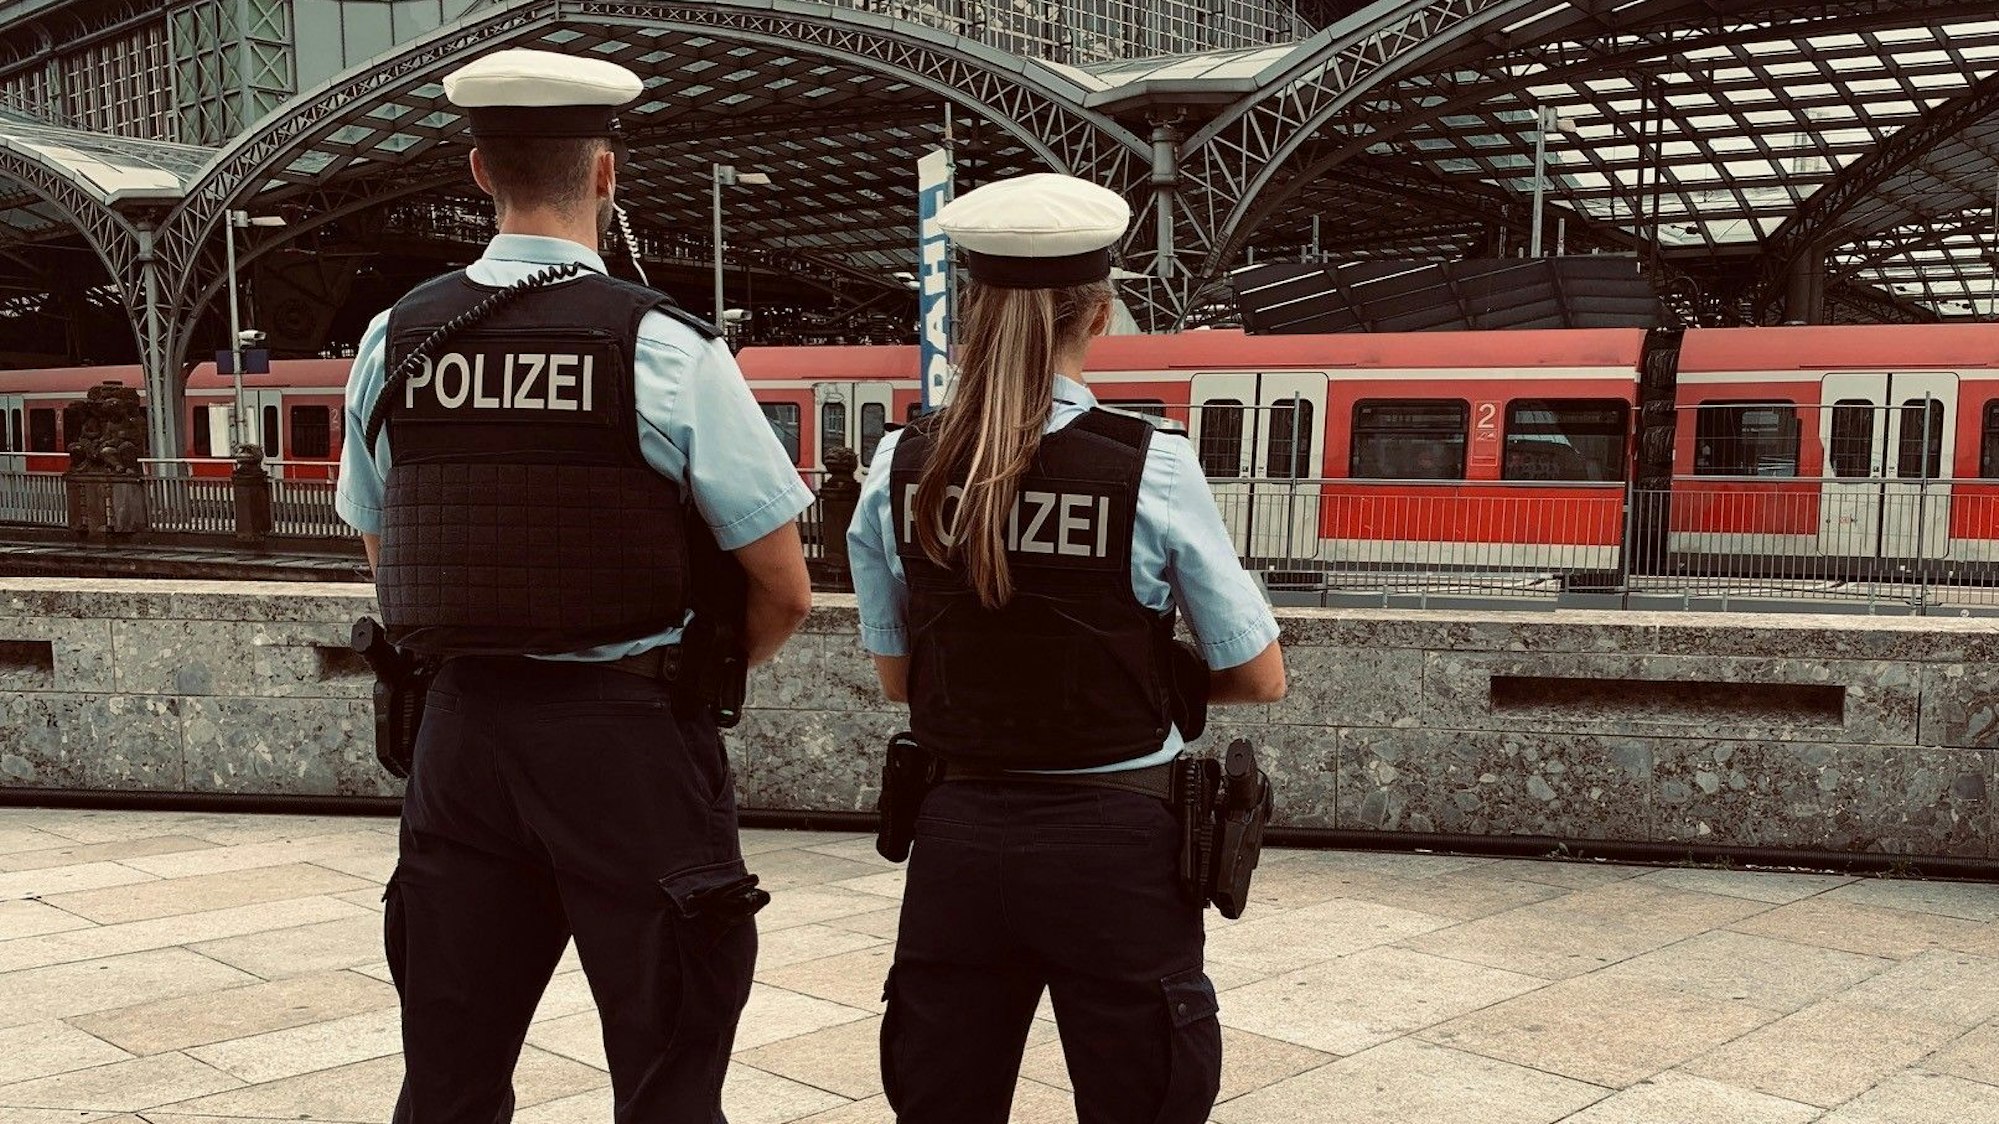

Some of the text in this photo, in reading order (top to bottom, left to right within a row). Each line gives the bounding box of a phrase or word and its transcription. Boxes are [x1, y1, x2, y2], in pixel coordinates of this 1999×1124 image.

[405, 352, 594, 411] POLIZEI
[1477, 403, 1496, 429] 2
[903, 483, 1110, 558] POIZEI
